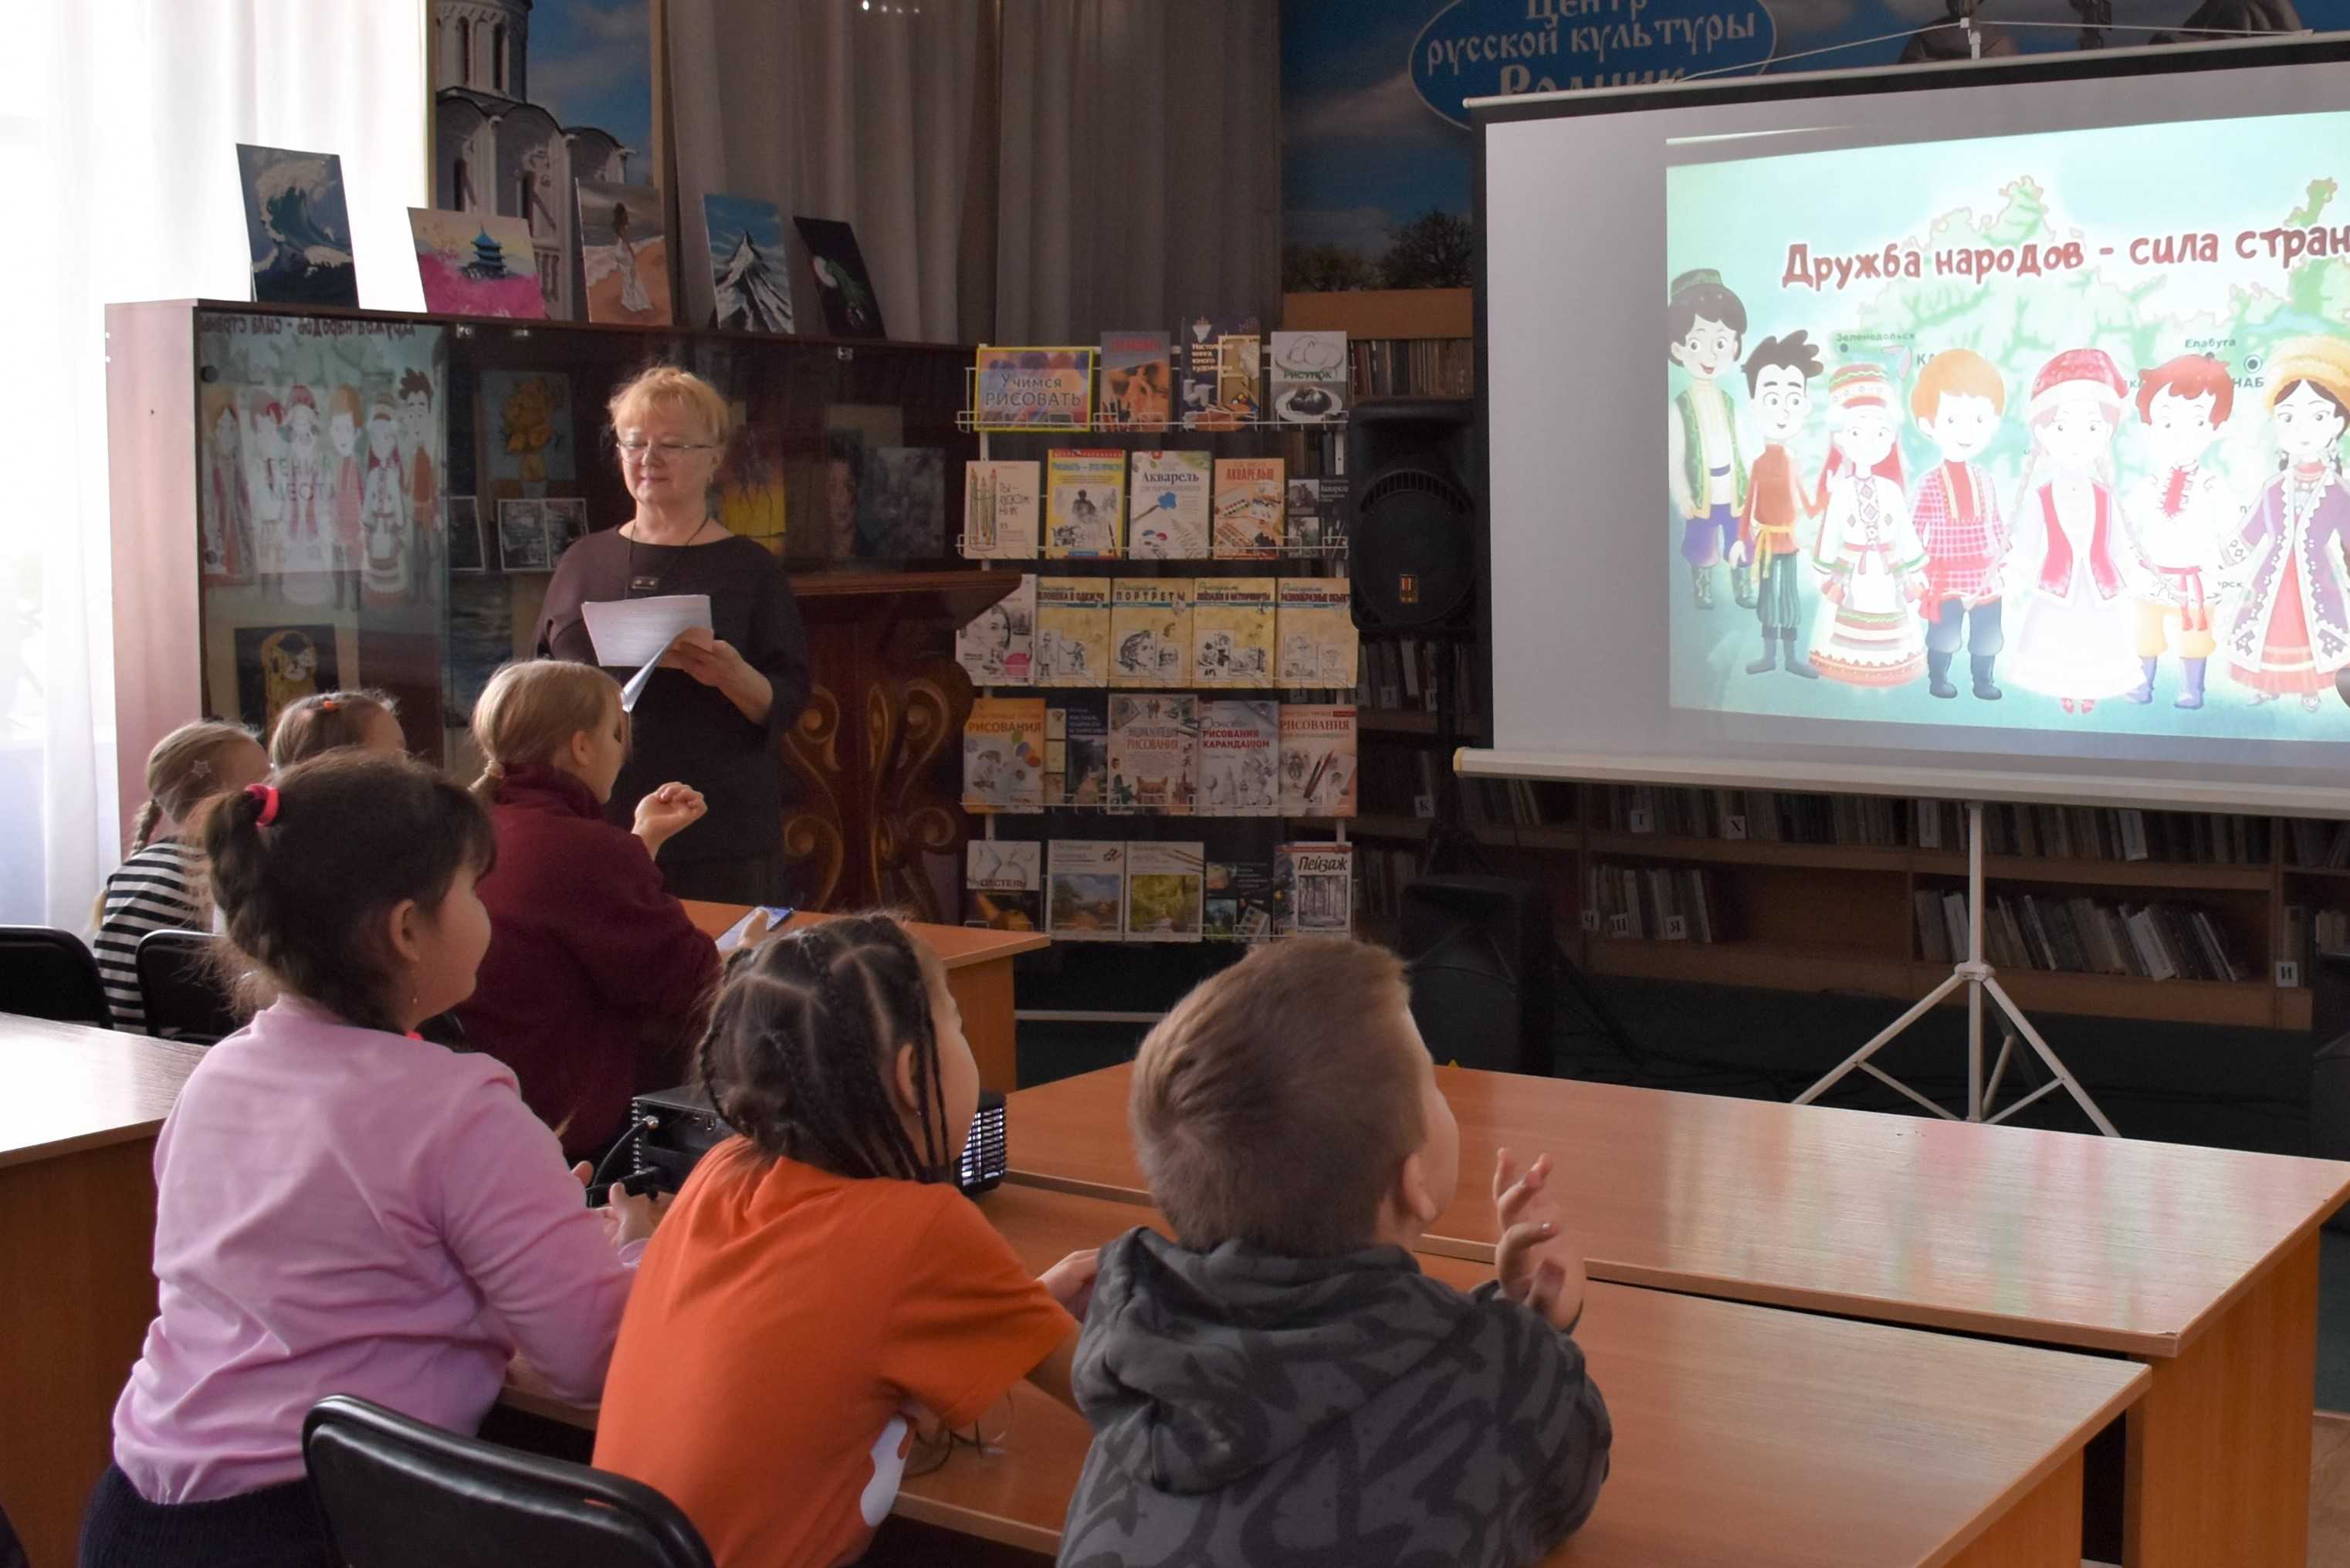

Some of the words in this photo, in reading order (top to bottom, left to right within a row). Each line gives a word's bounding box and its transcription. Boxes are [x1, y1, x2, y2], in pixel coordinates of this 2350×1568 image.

[1427, 22, 1559, 76] русской
[1570, 12, 1755, 63] культуры
[1782, 243, 1921, 292] Дружба
[1935, 242, 2084, 285] народов
[2129, 233, 2220, 266] сила
[2185, 337, 2237, 349] Елабуга
[985, 391, 1082, 407] РИСОВАТЬ
[1142, 472, 1200, 485] Акварель
[1116, 591, 1186, 601] ПОРТРЕТЫ
[968, 722, 1041, 733] РИСОВАНИЯ
[1279, 720, 1349, 730] РИСОВАНИЯ
[1202, 730, 1260, 738] РИСОВАНИЯ
[1203, 740, 1270, 749] КАРАНДАШОМ
[1298, 855, 1348, 872] Пейзаж
